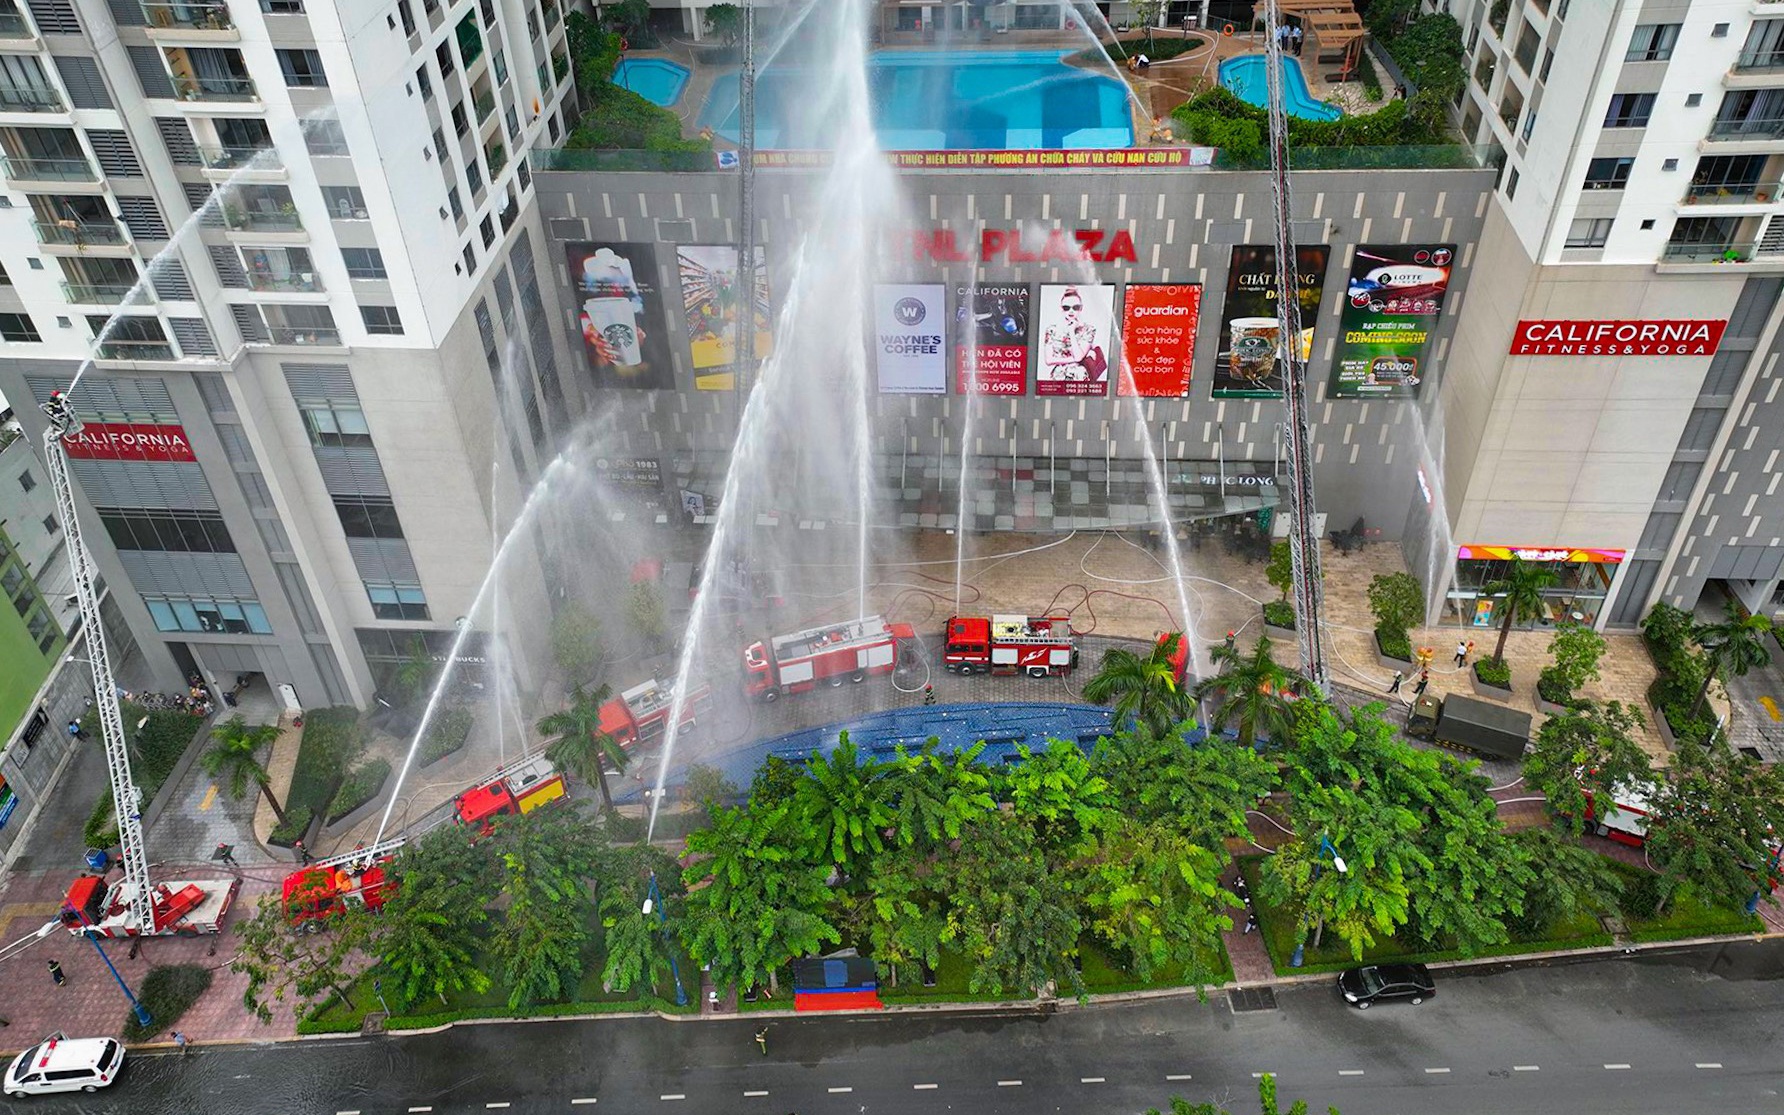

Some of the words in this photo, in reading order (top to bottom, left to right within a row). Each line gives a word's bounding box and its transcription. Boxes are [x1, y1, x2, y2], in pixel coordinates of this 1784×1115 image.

[900, 153, 924, 165] THỰC
[926, 153, 946, 165] HIỆN
[988, 152, 1024, 164] PHƯƠNG
[1025, 151, 1038, 164] ÁN
[1040, 151, 1064, 164] CHỮA
[1066, 151, 1089, 164] CHÁY
[1092, 151, 1105, 164] VÀ
[1127, 152, 1145, 165] NẠN
[1168, 151, 1182, 164] HỘ
[982, 228, 1138, 262] PLAZA
[1239, 271, 1272, 285] CHẤT
[957, 287, 1029, 296] CALIFORNIA
[1134, 305, 1189, 318] guardian
[1135, 325, 1156, 335] cửa
[1157, 325, 1183, 337] hàng
[1525, 324, 1709, 341] CALIFORNIA
[880, 335, 942, 345] WAYNE'S
[1136, 336, 1153, 345] sức
[1345, 331, 1393, 344] COMING
[1395, 331, 1428, 344] SOON
[884, 344, 938, 354] COFFEE
[987, 347, 1002, 358] ĐÃ
[1004, 348, 1022, 358] CÓ
[980, 359, 998, 369] HỘI
[1000, 359, 1021, 369] VIÊN
[1155, 355, 1176, 366] đẹp
[1133, 364, 1153, 374] của
[1154, 364, 1174, 375] bạn
[991, 382, 1020, 392] 6995
[63, 432, 186, 446] CALIFORNIA
[1238, 475, 1274, 486] LONG
